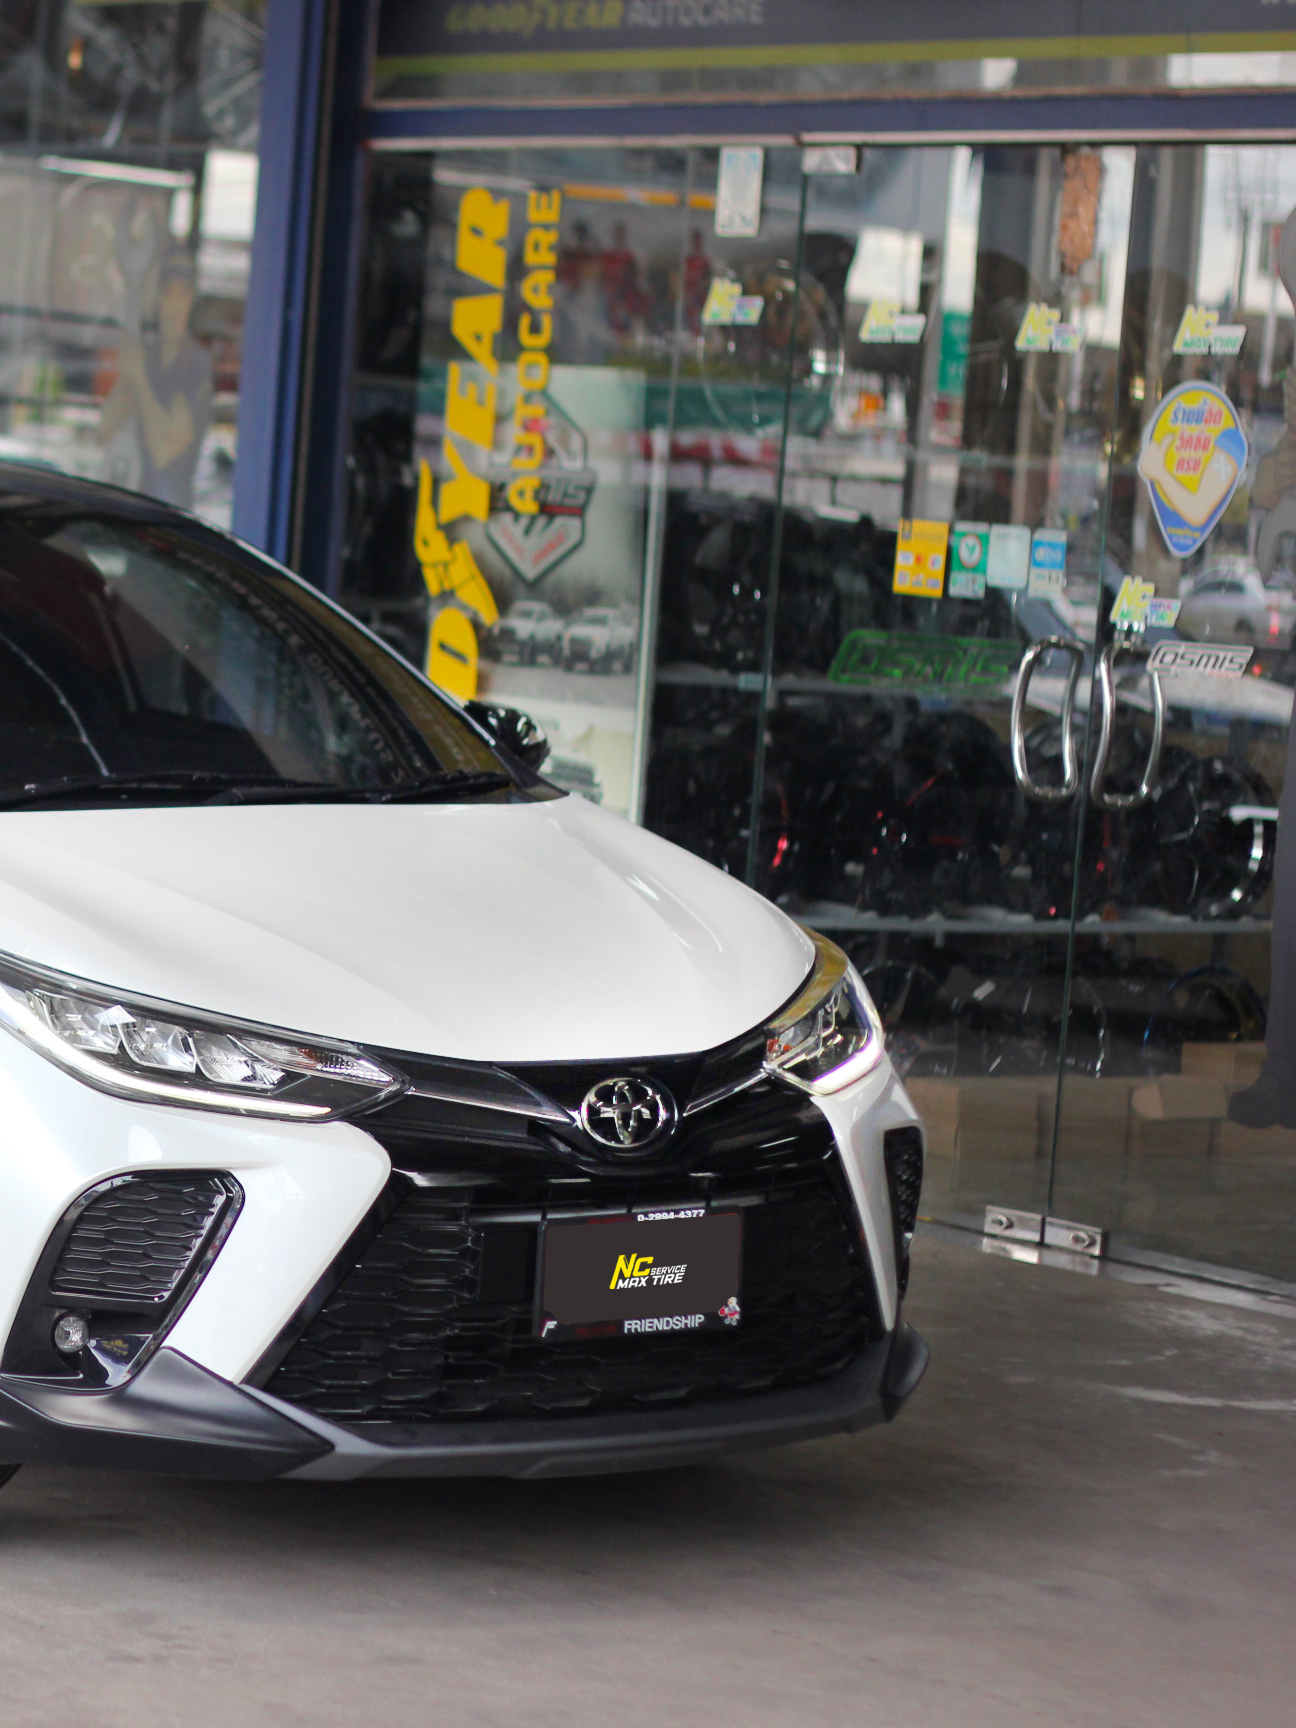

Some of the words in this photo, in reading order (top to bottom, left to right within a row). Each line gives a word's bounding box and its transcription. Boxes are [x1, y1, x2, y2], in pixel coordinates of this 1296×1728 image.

[446, 0, 623, 38] GOODYEAR
[627, 0, 764, 27] AUTOCARE
[508, 189, 562, 515] AUTOCARE
[1112, 578, 1155, 619] NC
[1150, 641, 1252, 675] COSMIS
[624, 1315, 705, 1333] FRIENDSHIP
